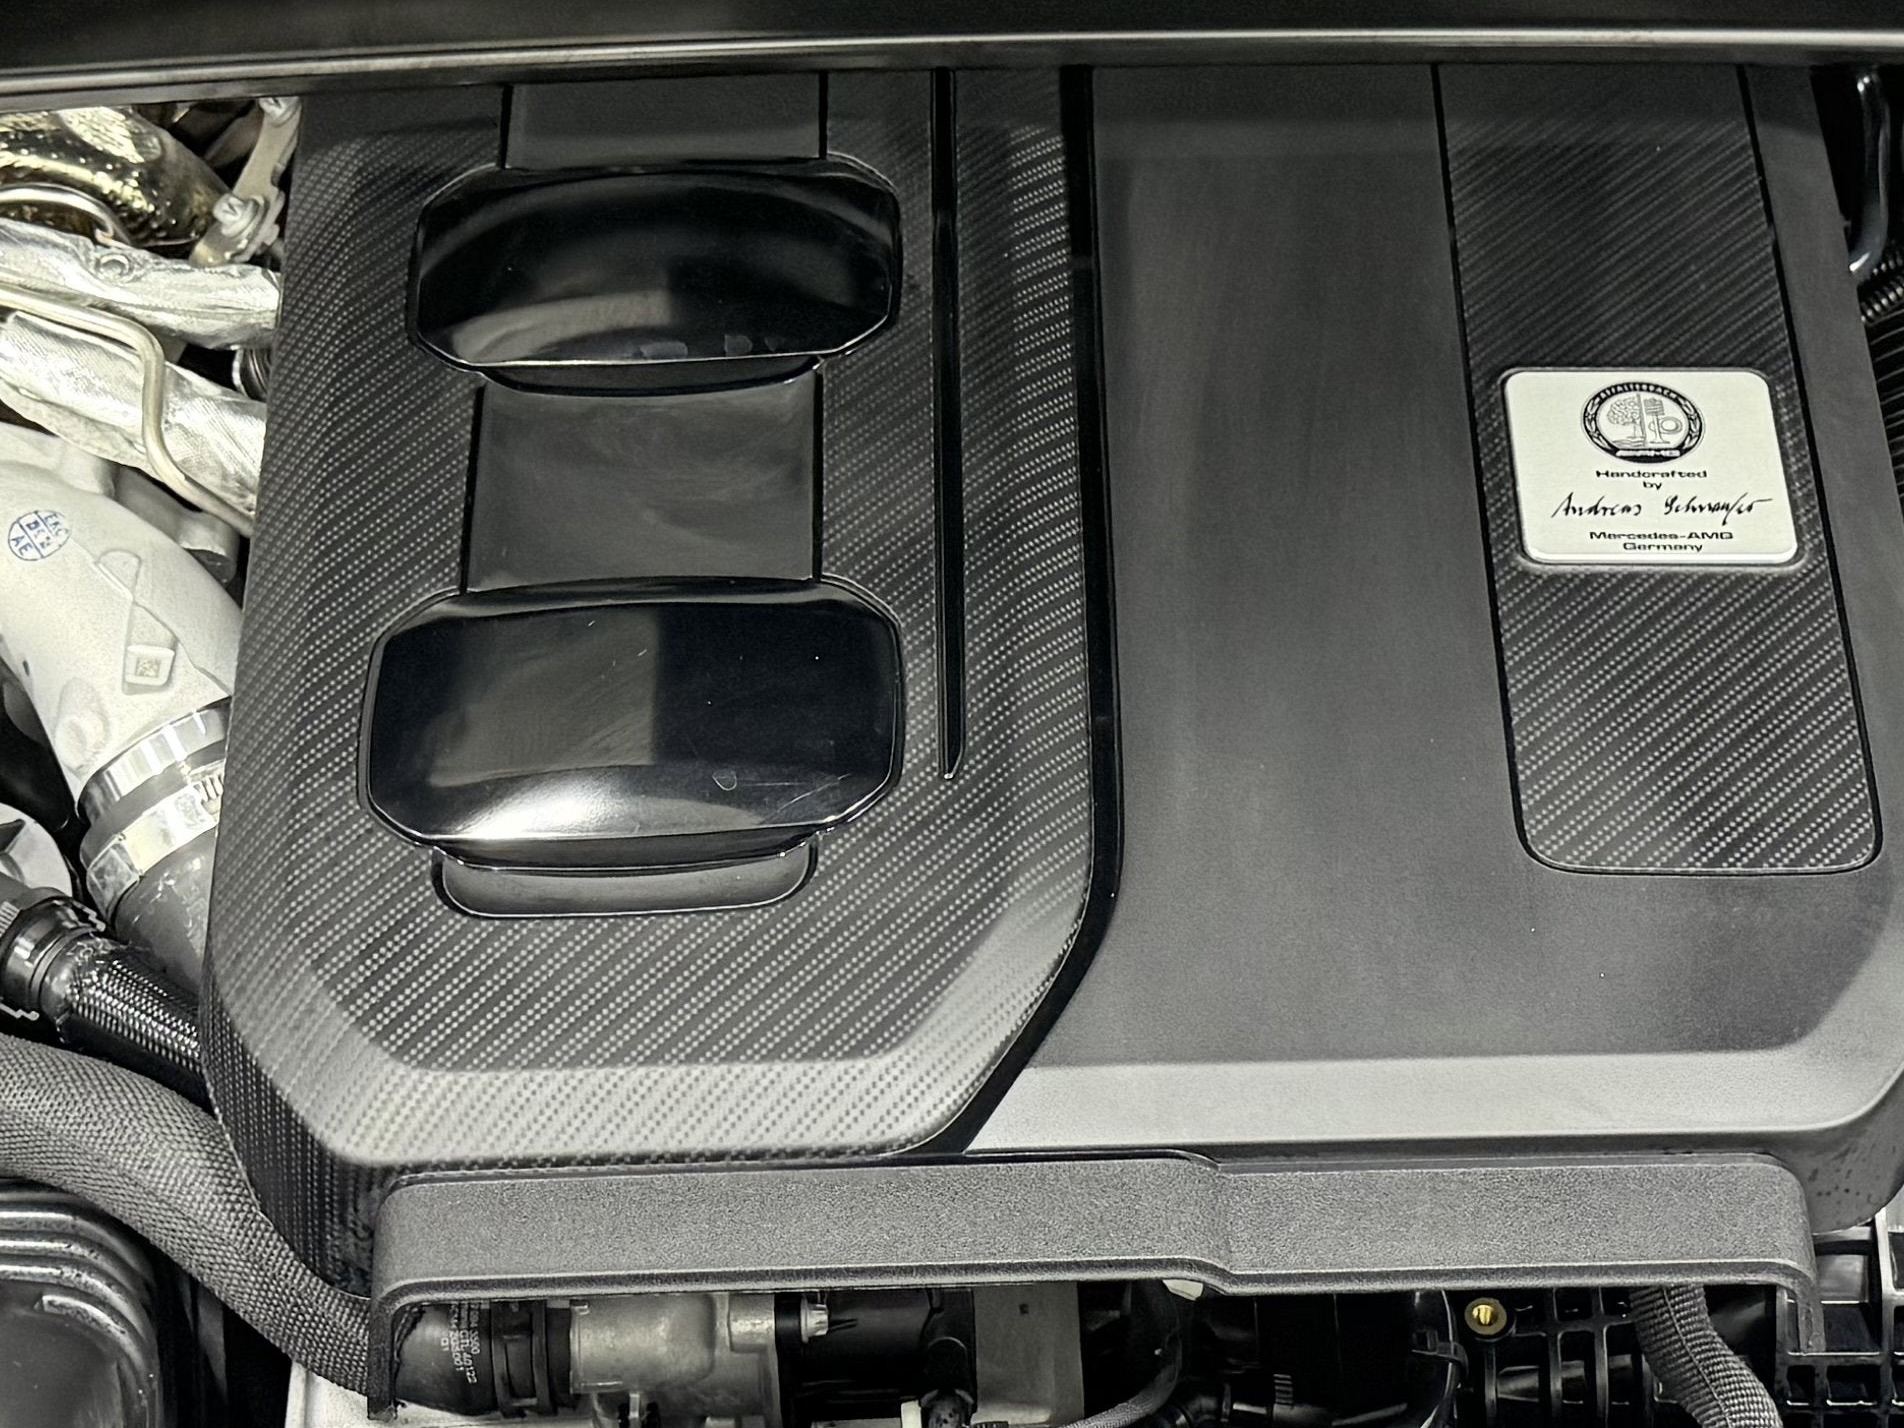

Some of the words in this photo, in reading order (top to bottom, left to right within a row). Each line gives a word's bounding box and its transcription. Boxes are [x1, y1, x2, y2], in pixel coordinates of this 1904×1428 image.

[1595, 470, 1708, 479] Handcrafted
[1643, 480, 1663, 490] by
[1551, 492, 1642, 518] Andreas
[1589, 531, 1733, 540] Mercedes-AMG
[1622, 542, 1703, 552] Germany
